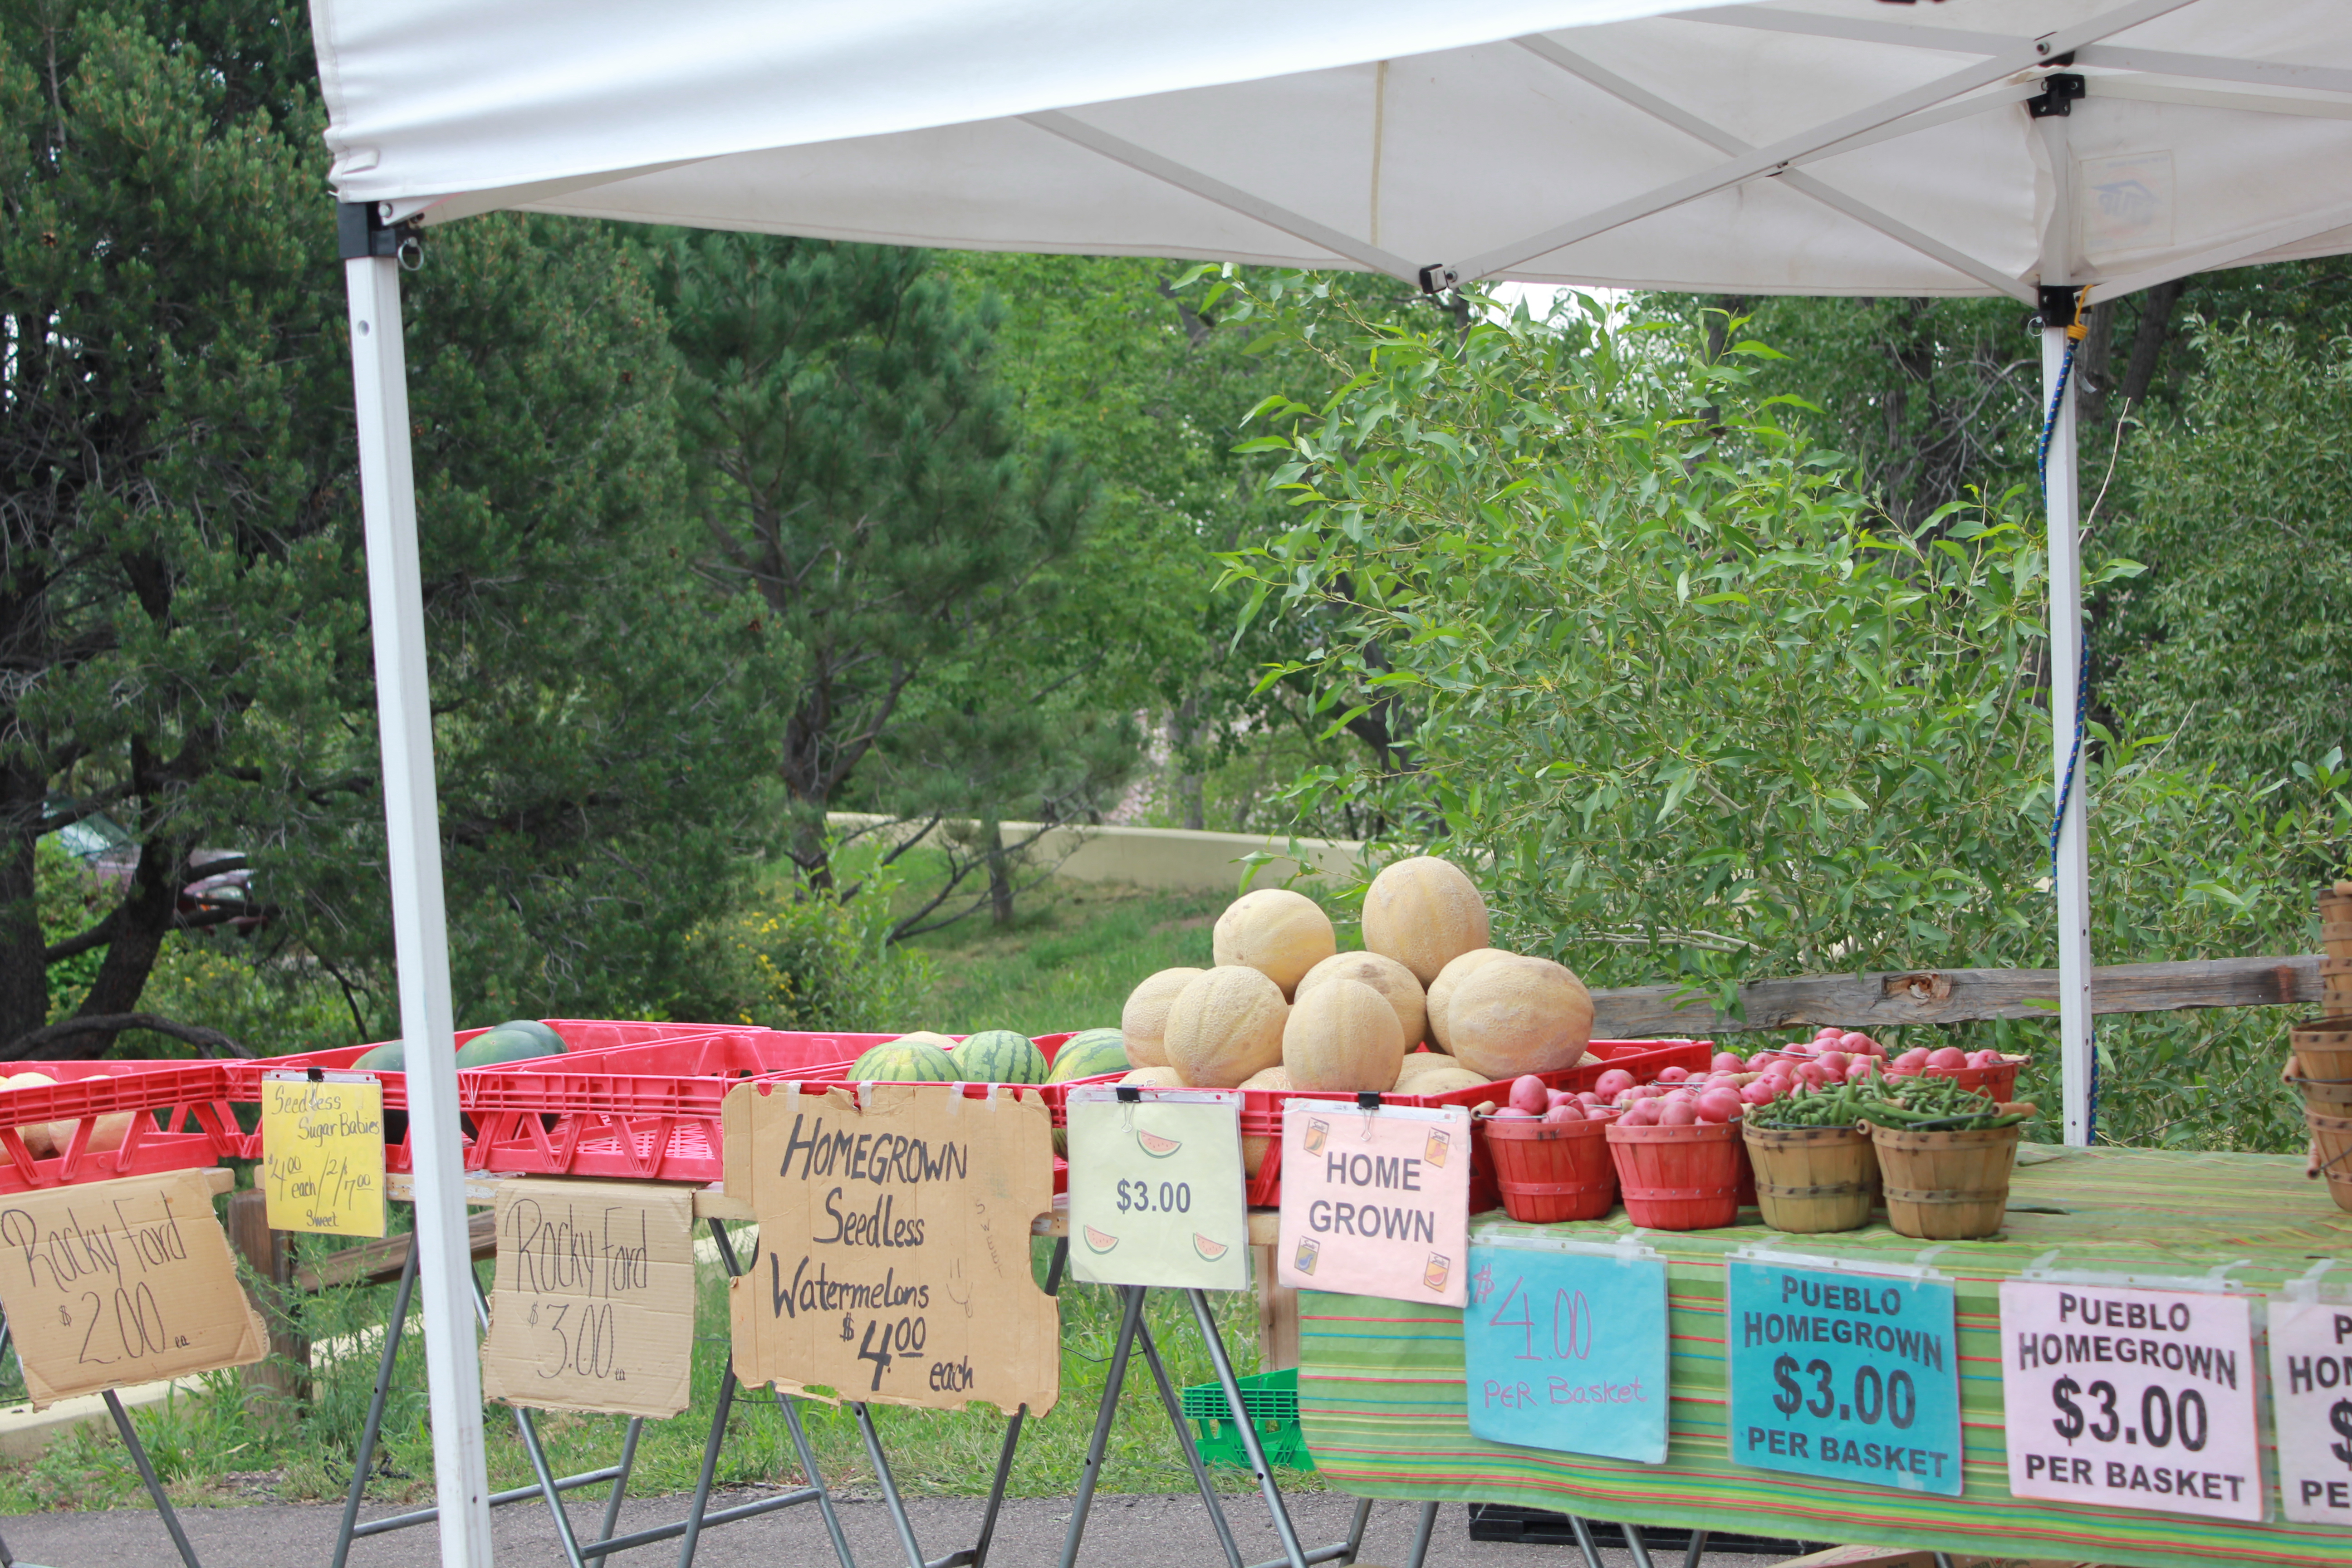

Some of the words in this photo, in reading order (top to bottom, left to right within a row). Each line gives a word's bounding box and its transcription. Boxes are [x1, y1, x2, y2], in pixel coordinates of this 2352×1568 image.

[298, 1117, 338, 1148] Sugar
[339, 1110, 381, 1137] Babies
[780, 1113, 967, 1185] HOMEGROWN
[1116, 1178, 1191, 1215] $3.00
[1327, 1151, 1422, 1192] HOME
[1, 1207, 122, 1292] Rocky
[112, 1190, 187, 1273] Ford
[306, 1209, 339, 1227] Sweet
[1308, 1200, 1435, 1244] GROWN
[505, 1199, 595, 1298] Rocky
[601, 1206, 647, 1299] Ford
[770, 1252, 930, 1318] Watermelons
[1473, 1263, 1592, 1361] $4.00
[1781, 1274, 1901, 1316] PUEBLO
[2058, 1291, 2190, 1332] PUEBLO
[59, 1281, 165, 1364] $2.00
[527, 1300, 614, 1379] $3.00
[1744, 1311, 1943, 1373] HOMEGROWN
[930, 1356, 974, 1392] each
[2018, 1332, 2237, 1391] HOMEGROWN
[1547, 1376, 1648, 1405] Basket
[1772, 1352, 1916, 1430] $3.00
[2052, 1373, 2208, 1452] $3.00
[1748, 1426, 1810, 1459] PER
[1820, 1436, 1948, 1478] BASKET
[2024, 1453, 2094, 1486] PER
[2105, 1460, 2245, 1503] BASKET
